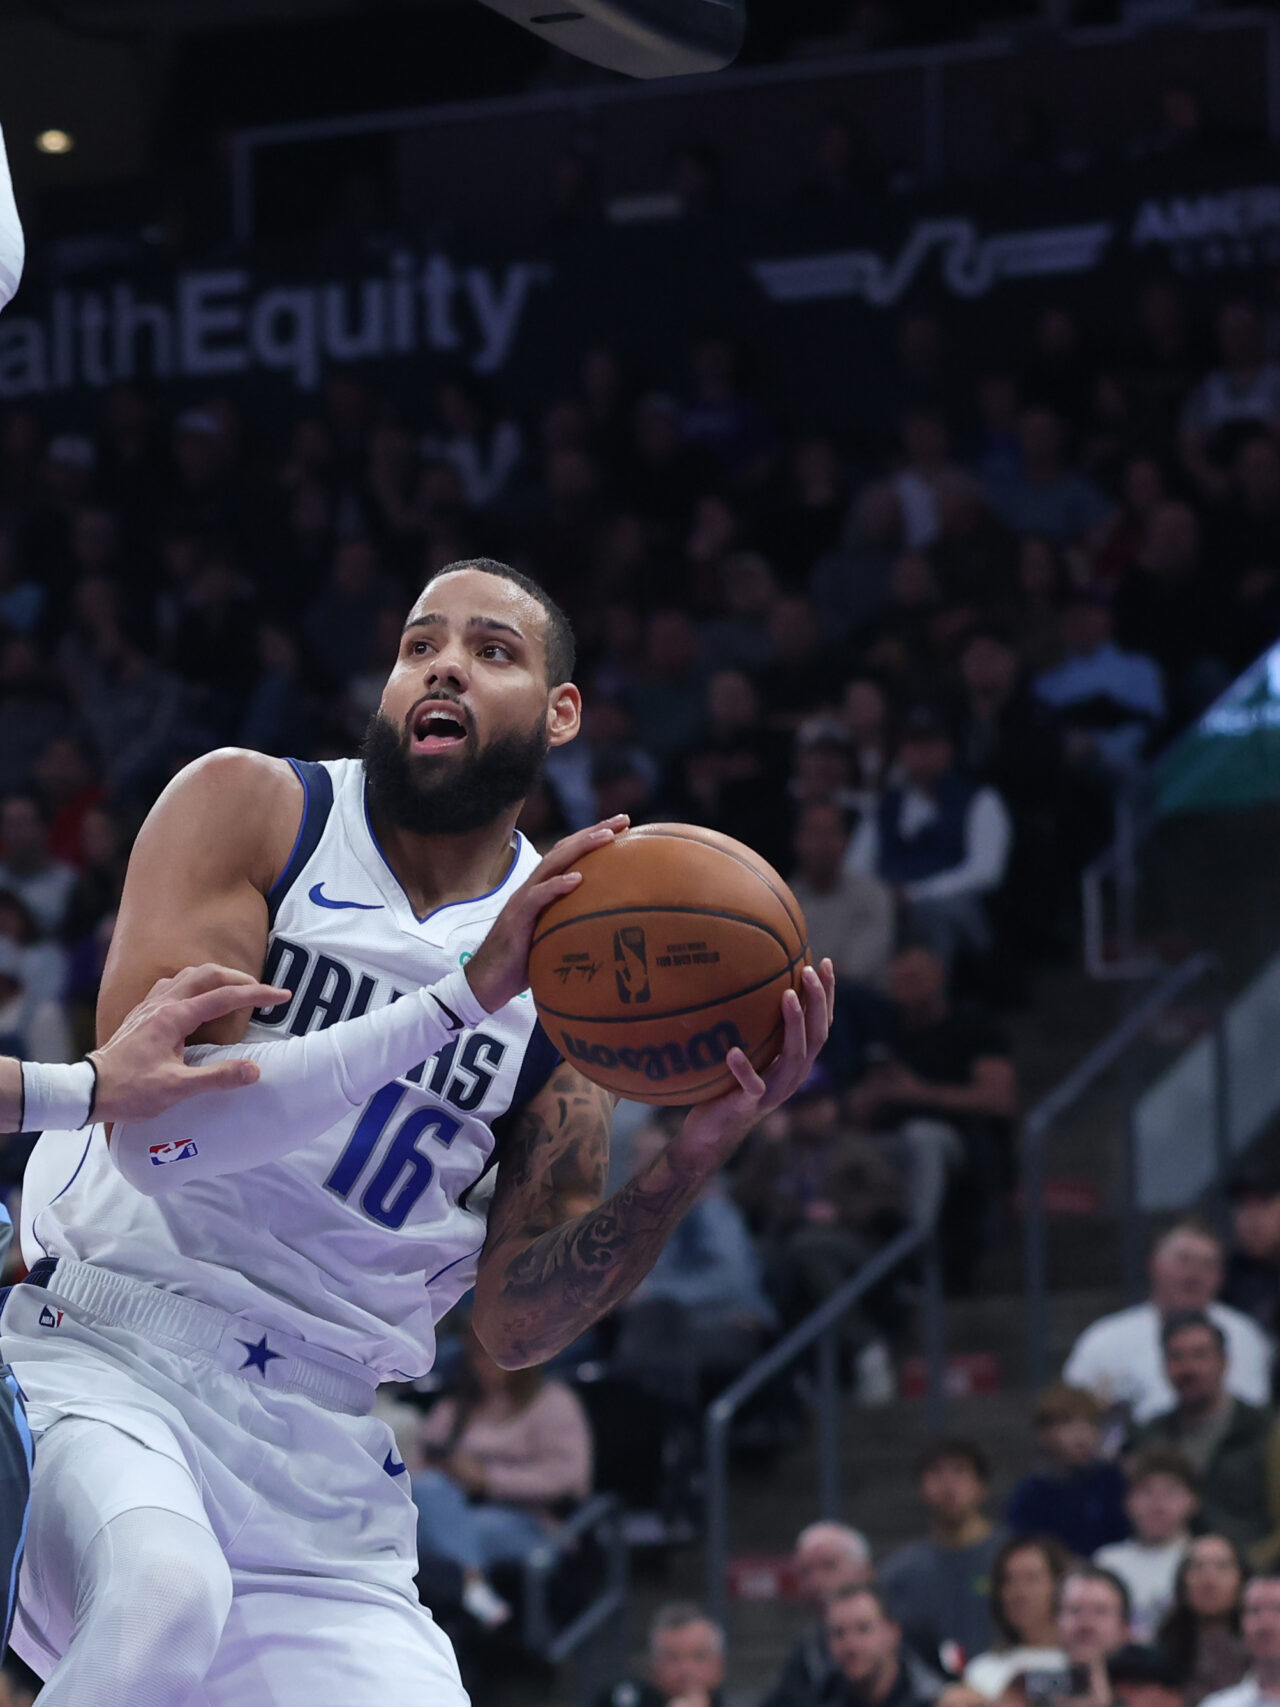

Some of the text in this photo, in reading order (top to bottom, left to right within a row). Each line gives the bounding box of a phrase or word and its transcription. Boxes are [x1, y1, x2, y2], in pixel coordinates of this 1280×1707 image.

[251, 936, 509, 1113] DAAS
[560, 1020, 749, 1082] Wilson
[323, 1079, 467, 1232] 16
